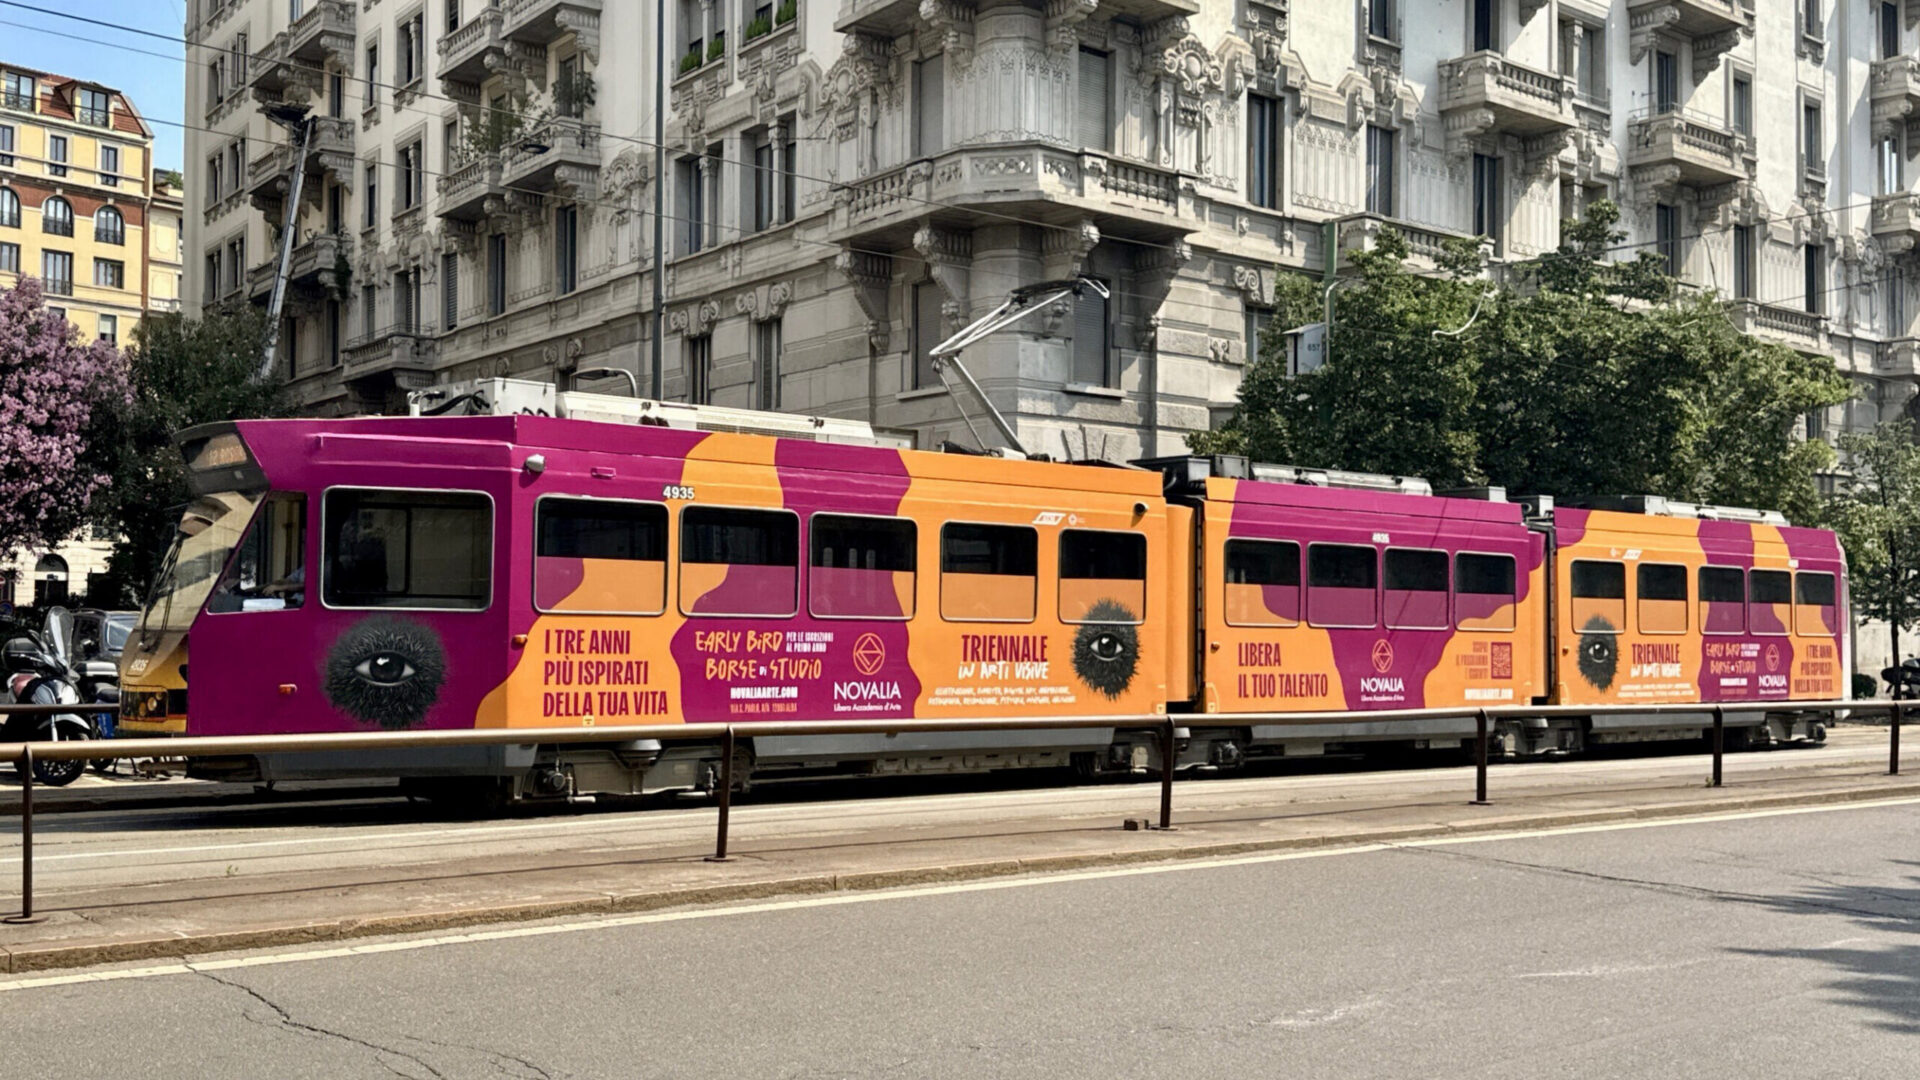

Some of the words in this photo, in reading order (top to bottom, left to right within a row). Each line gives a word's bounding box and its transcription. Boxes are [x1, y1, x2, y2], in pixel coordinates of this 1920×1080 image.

[662, 485, 695, 500] 4935
[545, 629, 550, 654] I
[555, 630, 585, 654] TRE
[589, 630, 631, 655] ANNI
[695, 630, 741, 654] EARLY
[961, 635, 1048, 662] TRIENNALE
[1632, 643, 1680, 664] TRIENNALE
[1238, 642, 1281, 667] LIBERA
[544, 655, 573, 685] PIÙ
[578, 660, 648, 685] ISPIRATI
[705, 658, 757, 681] BORSE
[1758, 675, 1787, 687] NOVALIA
[730, 686, 798, 699] NOVALIAARTE.COM
[833, 681, 901, 700] NOVALIA
[1238, 674, 1249, 698] IL
[1252, 674, 1276, 698] TUO
[1279, 673, 1328, 697] TALENTO
[1360, 677, 1404, 692] NOVALIA
[543, 692, 593, 717] DELLA
[598, 691, 629, 716] TUA
[634, 691, 668, 715] VITA
